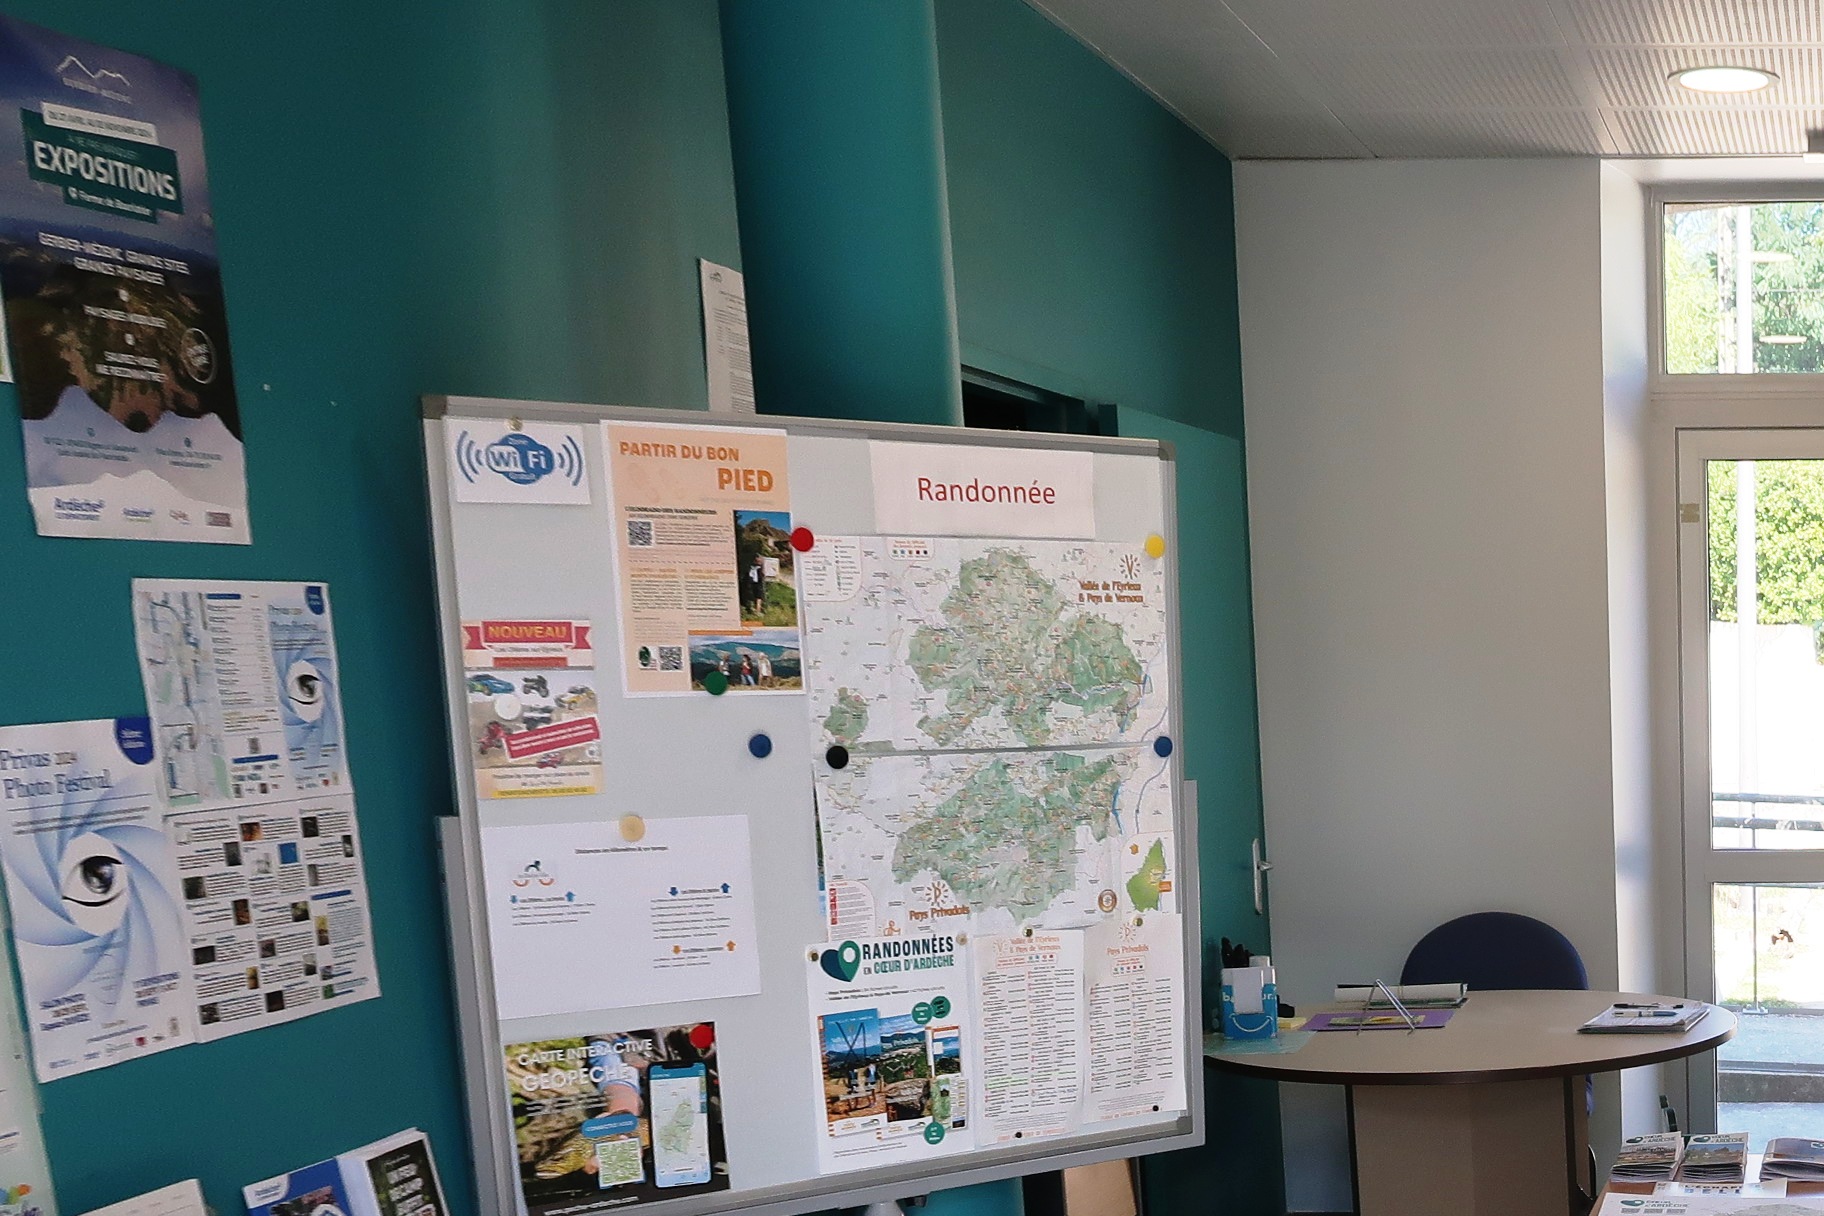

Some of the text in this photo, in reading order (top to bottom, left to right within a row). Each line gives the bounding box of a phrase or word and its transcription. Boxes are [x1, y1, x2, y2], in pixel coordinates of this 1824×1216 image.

[33, 140, 177, 200] EXPOSITIONS
[620, 441, 739, 462] PARTIR DU BON
[717, 467, 774, 492] PIED
[917, 476, 1056, 505] Randonnée
[488, 626, 567, 639] NOUVEAU
[909, 905, 970, 921] Pays Privadois
[862, 934, 954, 960] RANDONNÉES
[873, 960, 901, 974] CŒUR
[904, 953, 955, 971] D'ARDÈCHE
[518, 1038, 653, 1066] CARTE INTERACTIVE
